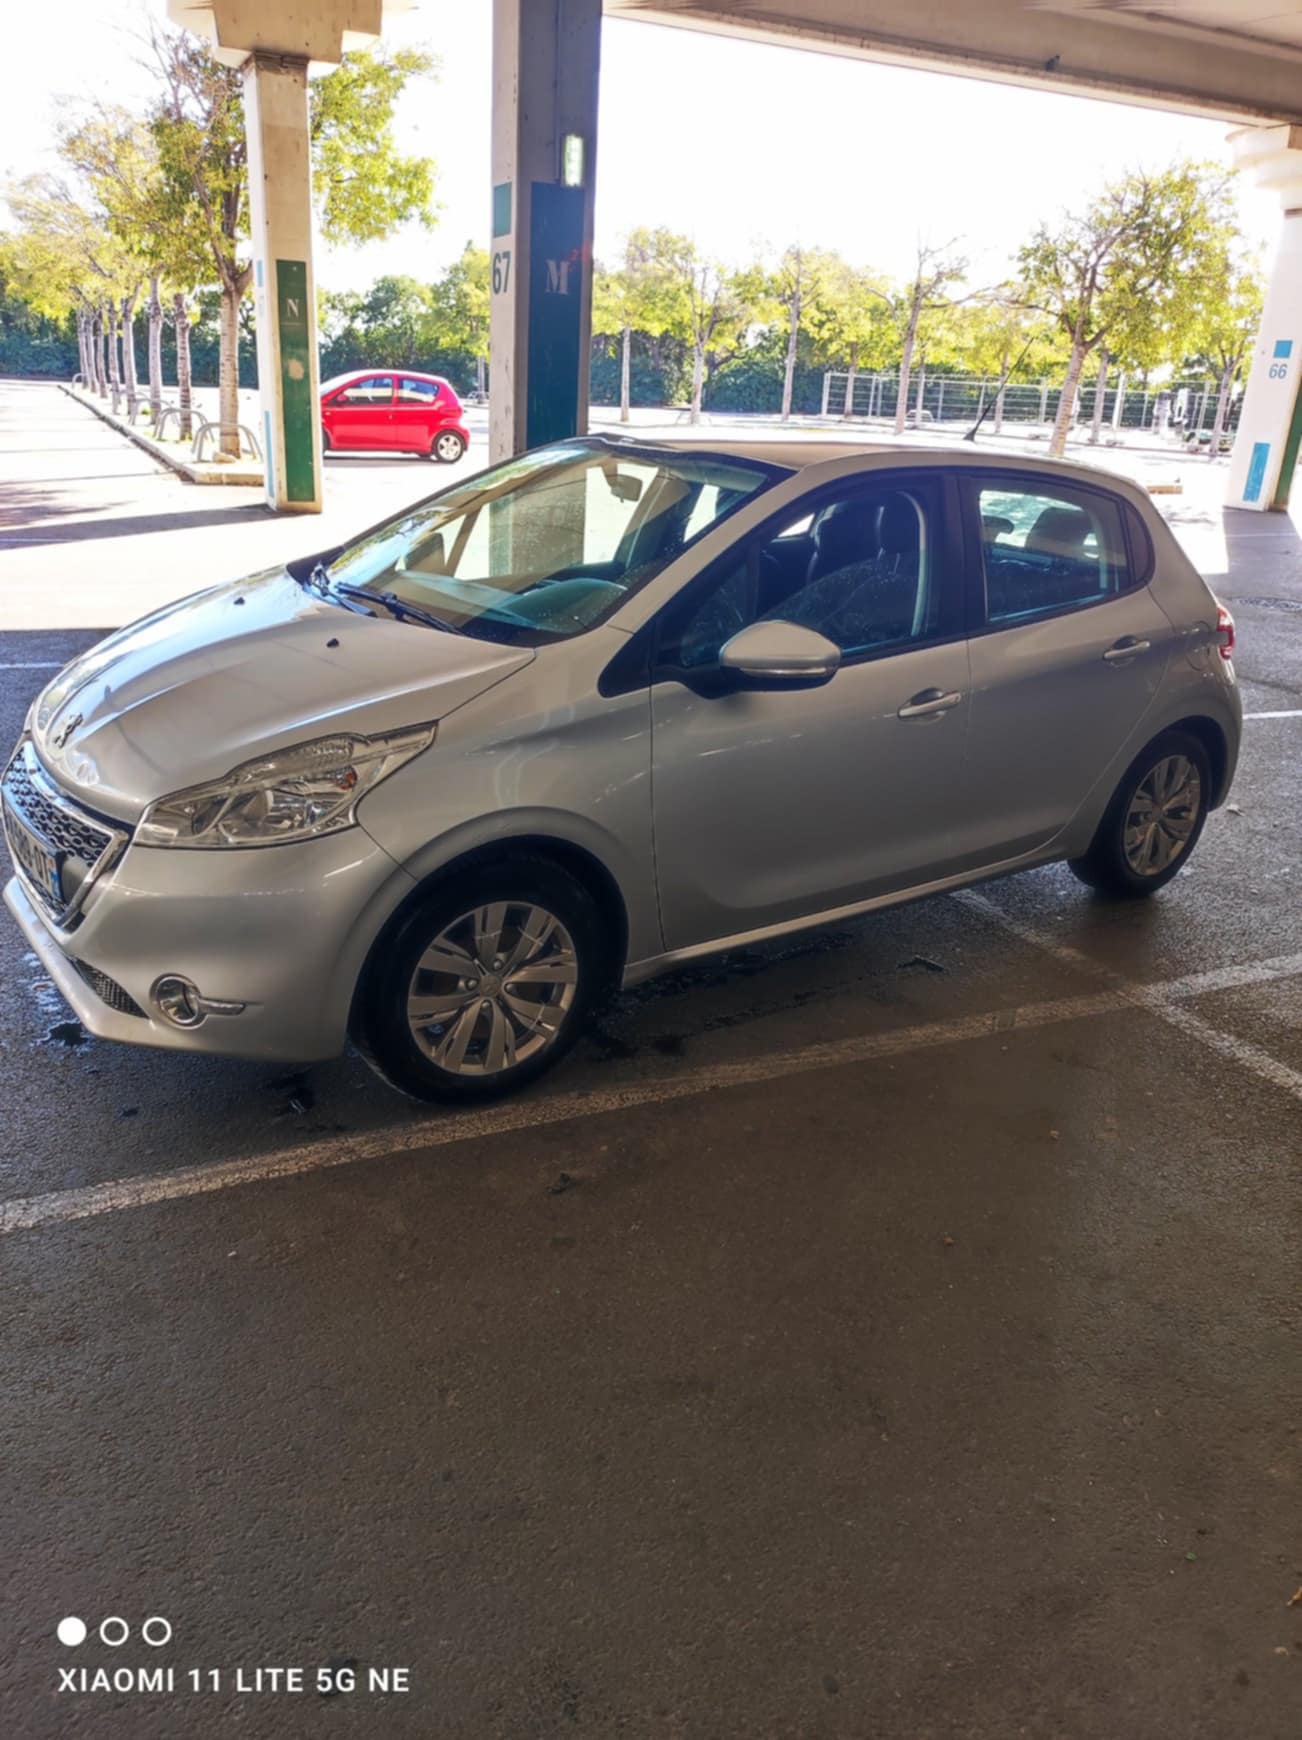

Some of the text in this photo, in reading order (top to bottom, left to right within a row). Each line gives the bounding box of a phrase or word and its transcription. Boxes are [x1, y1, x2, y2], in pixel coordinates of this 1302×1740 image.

[492, 250, 511, 295] 67
[544, 258, 570, 295] M
[286, 298, 299, 318] N
[1268, 363, 1288, 379] 66
